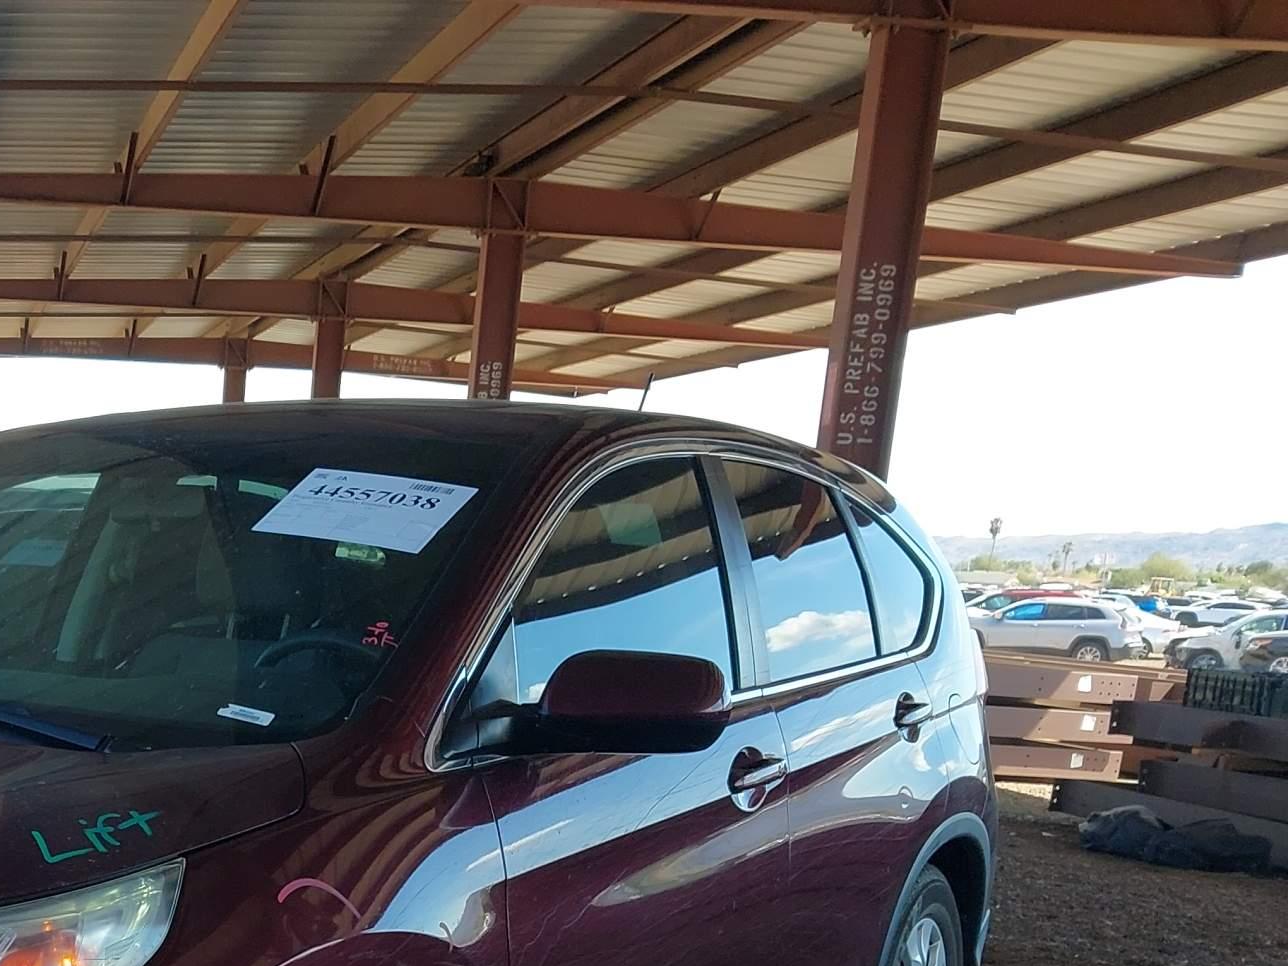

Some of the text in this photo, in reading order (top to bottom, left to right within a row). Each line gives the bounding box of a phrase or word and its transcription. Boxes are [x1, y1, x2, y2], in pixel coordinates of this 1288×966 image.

[836, 262, 877, 444] U.S. PREFAB INC.
[856, 264, 896, 443] 1-866-799-0969
[308, 484, 441, 510] 44557038
